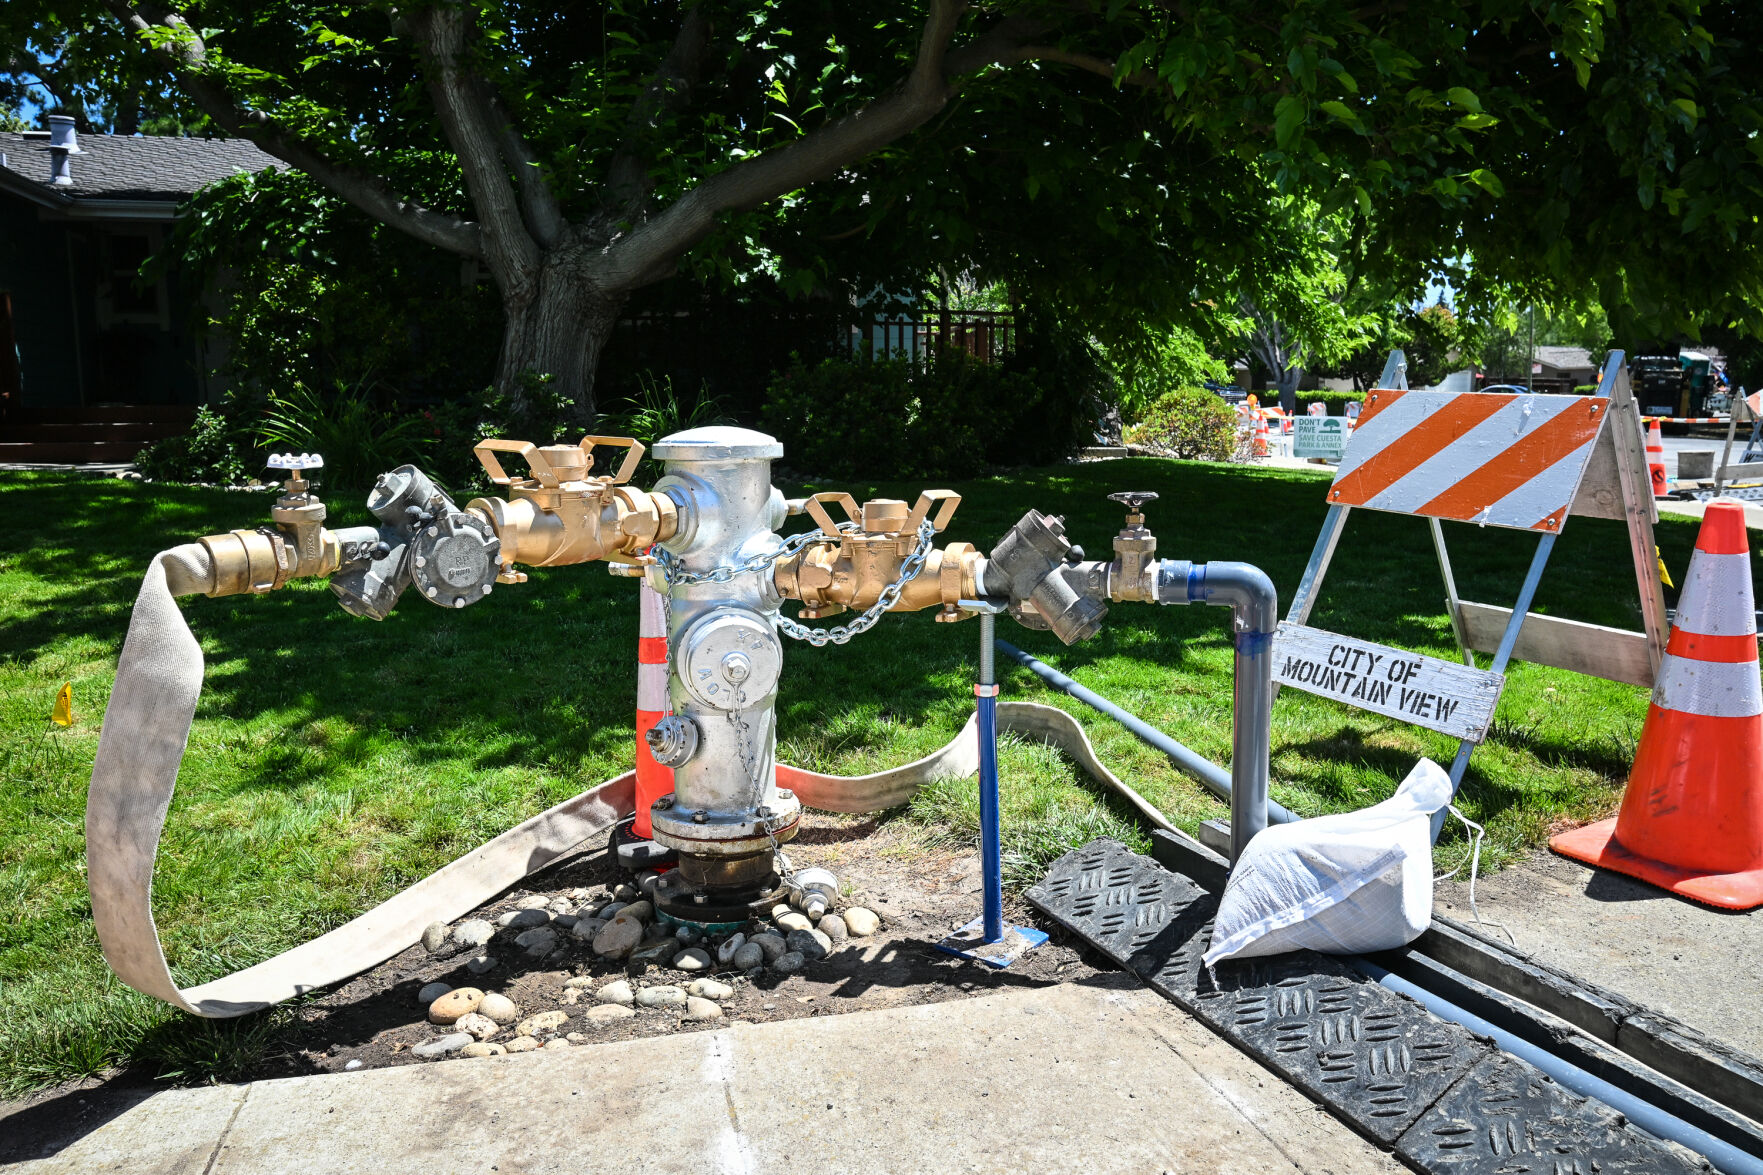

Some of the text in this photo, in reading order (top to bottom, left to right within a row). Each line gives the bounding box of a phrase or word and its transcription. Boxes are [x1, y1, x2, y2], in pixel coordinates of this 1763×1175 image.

[1281, 656, 1459, 722] MOUNTAIN VIEW
[1328, 644, 1422, 685] CITY OF
